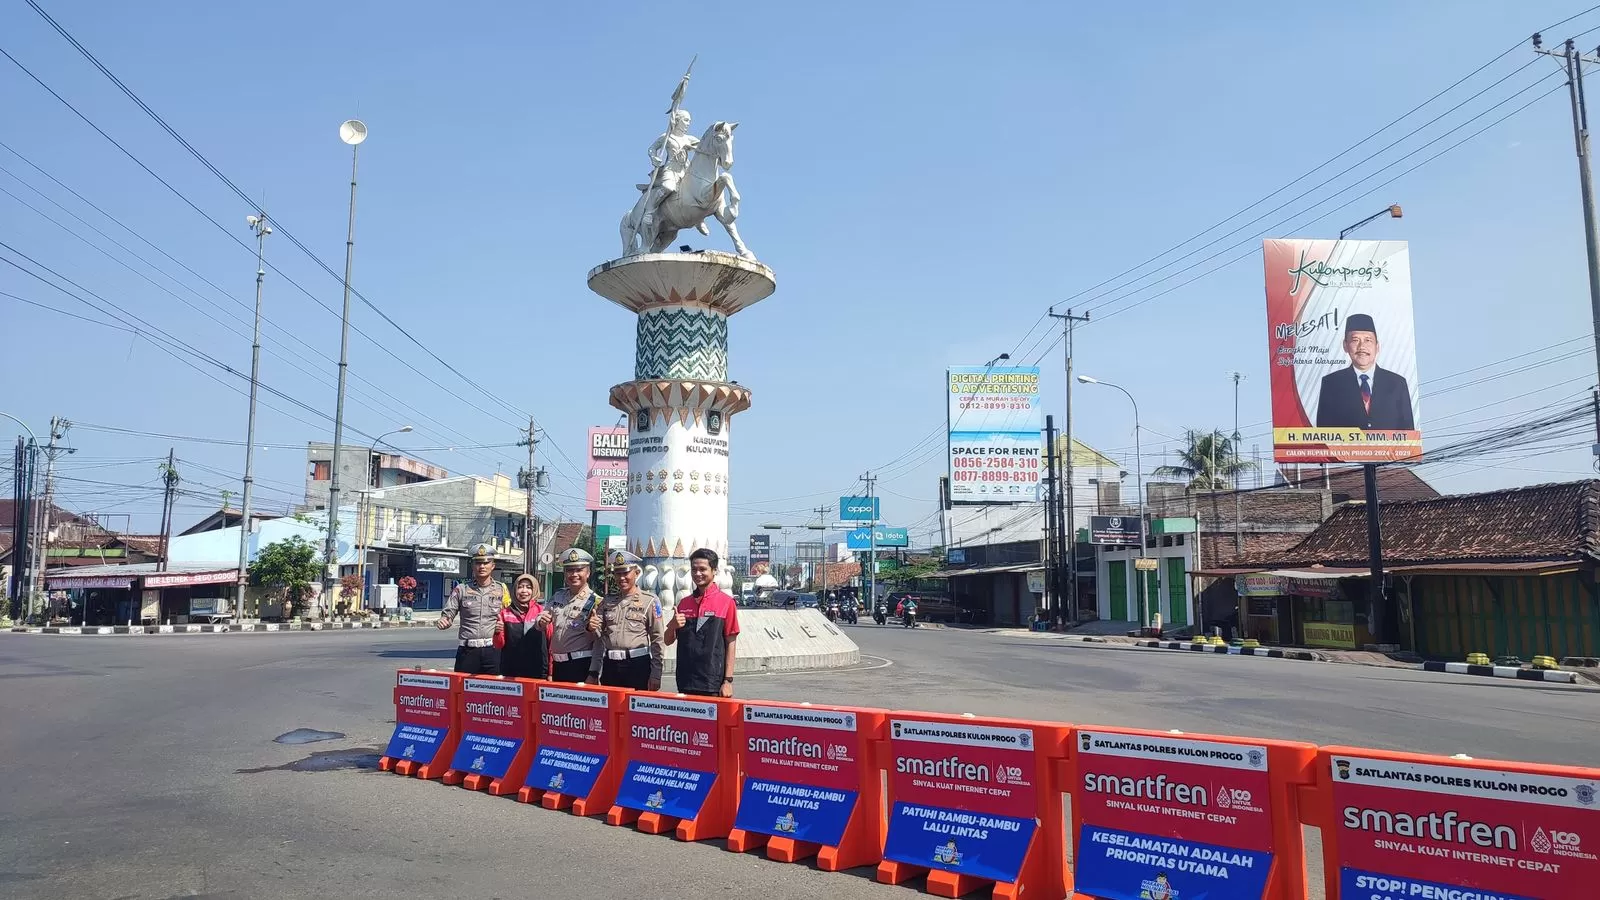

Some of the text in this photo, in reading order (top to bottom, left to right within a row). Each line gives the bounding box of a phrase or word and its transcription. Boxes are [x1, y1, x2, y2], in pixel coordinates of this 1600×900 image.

[951, 374, 1038, 384] DIGITAL PRINTING
[951, 384, 1038, 394] & ADVERTISING
[1303, 433, 1344, 442] MARIJA,
[686, 446, 712, 454] KULON
[954, 457, 1038, 468] 0856-2584-310
[954, 470, 1038, 482] 0877-8899-8310
[162, 576, 188, 584] LETHEK
[400, 694, 434, 708] smartfren
[466, 702, 504, 716] smartfren
[542, 713, 586, 730] smartfren
[754, 712, 783, 720] SATLANTAS
[632, 725, 688, 744] smartfren
[904, 728, 940, 738] SATLANTAS
[941, 731, 966, 740] POLRES
[967, 733, 990, 742] KULON
[748, 736, 822, 759] smartfren
[835, 744, 847, 754] 100
[1094, 740, 1243, 761] SATLANTAS POLRES KULON PROGO
[554, 751, 591, 763] PENGGUNAAN
[554, 760, 590, 772] BERKENDARA
[637, 765, 700, 781] JAUH DEKAT WAJIB
[794, 761, 820, 770] INTERNET
[896, 756, 1022, 782] smartfren 100
[633, 774, 698, 791] GUNAKAN HELM SNI
[912, 780, 936, 789] SINYAL
[954, 785, 988, 795] INTERNET
[988, 789, 1012, 797] CEPAT
[1084, 773, 1252, 806] smartfren 100
[1356, 767, 1568, 798] SATLANTAS POLRES KULON PROGO
[752, 782, 845, 802] PATUHI RAMBU-RAMBU
[768, 795, 820, 810] LALU LINTAS
[1232, 804, 1264, 813] INDONESIA
[902, 806, 1020, 832] PATUHI RAMBU-RAMBU
[1106, 800, 1237, 825] SINYAL KUAT INTERNET CEPAT
[923, 821, 988, 840] LALU LINTAS
[1344, 806, 1580, 850] smartfren 100
[1092, 832, 1253, 868] KESELAMATAN ADALAH
[1553, 844, 1581, 852] UNTUK
[1553, 850, 1598, 860] INDONESIA
[1106, 847, 1229, 879] PRIORITAS UTAMA
[1374, 839, 1560, 874] SINYAL KUAT INTERNET CEPAT
[1356, 876, 1406, 894] STOP!
